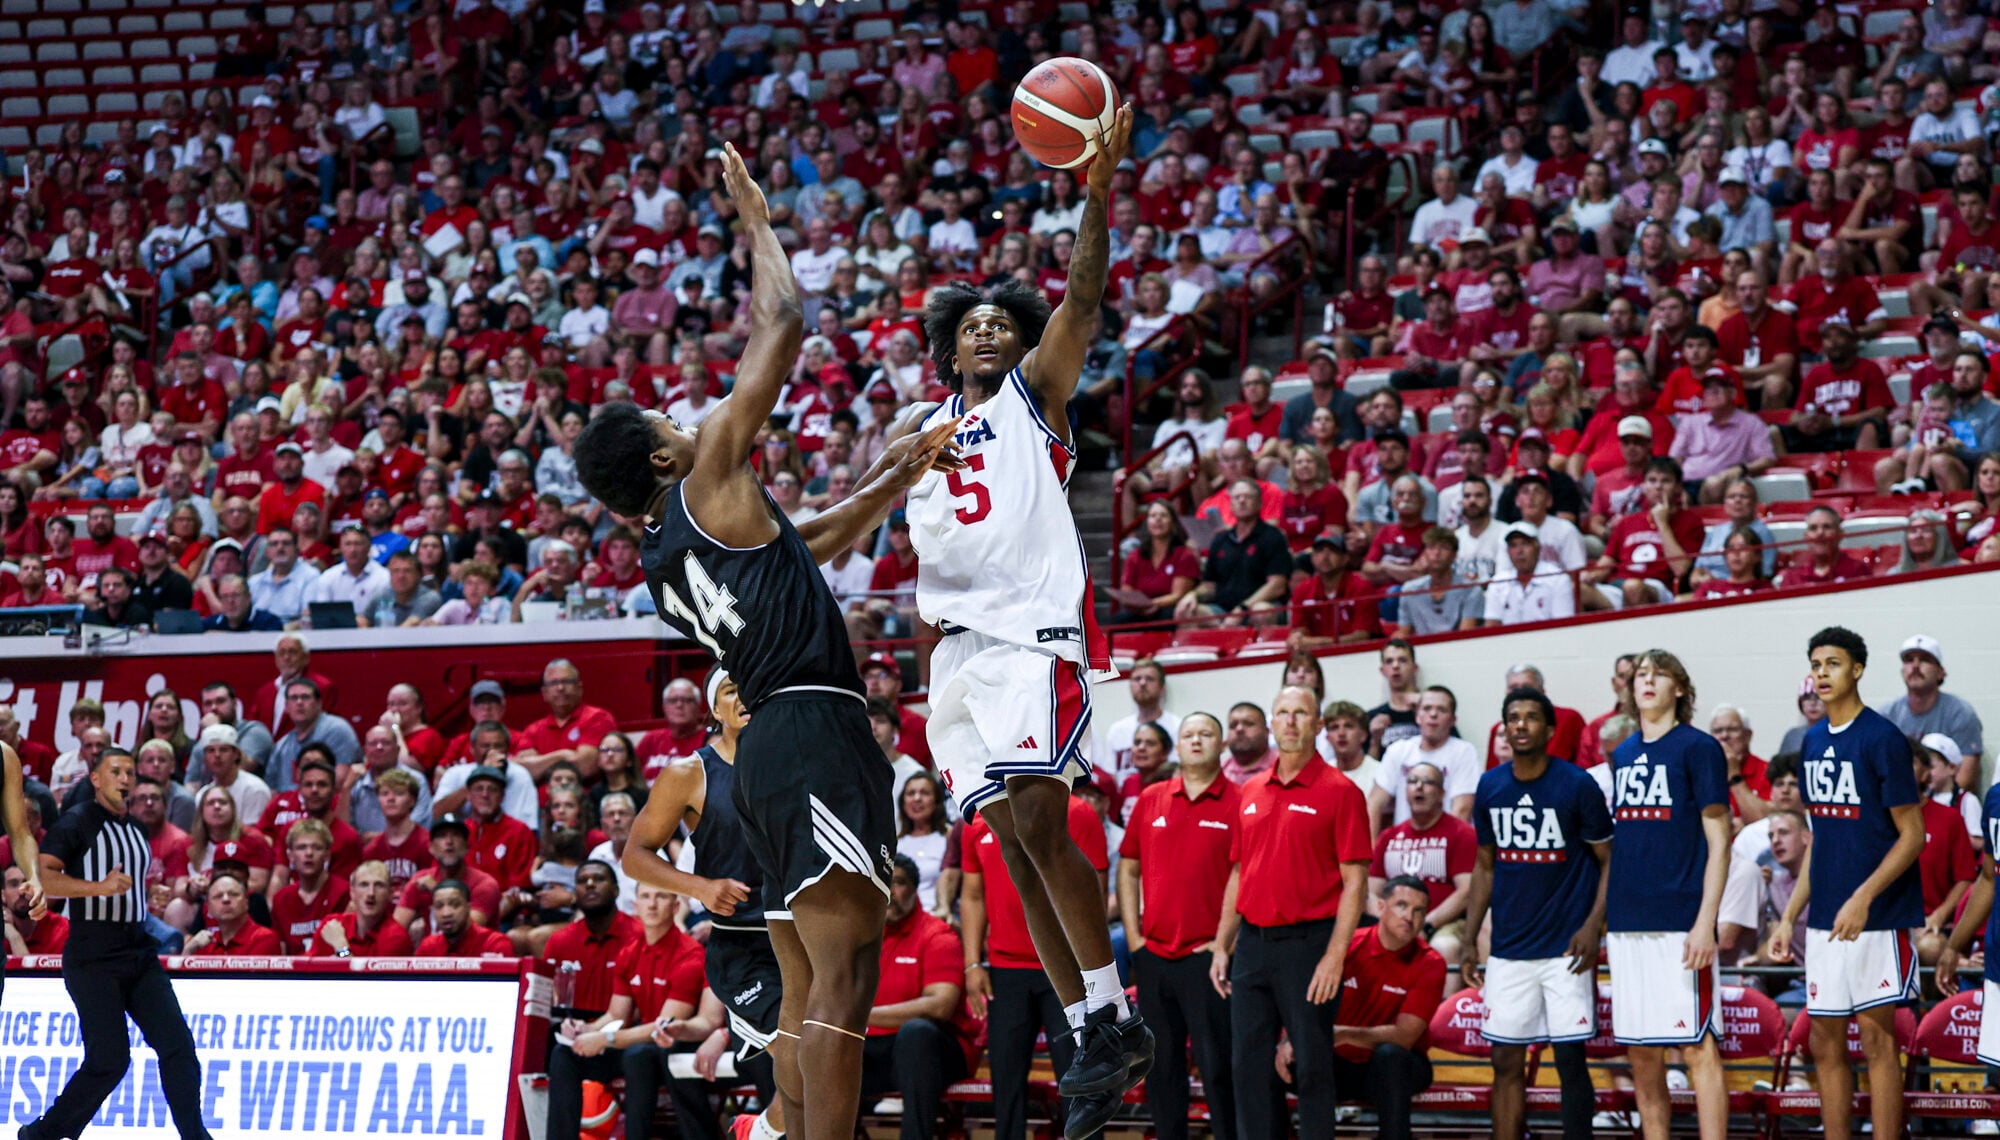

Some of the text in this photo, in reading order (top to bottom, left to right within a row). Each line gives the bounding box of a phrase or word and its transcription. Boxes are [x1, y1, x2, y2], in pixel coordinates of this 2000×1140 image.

[946, 453, 992, 525] 5
[662, 549, 746, 661] 14
[1616, 764, 1673, 806] USA
[1804, 760, 1861, 804] USA
[1489, 807, 1566, 849] USA
[184, 957, 222, 969] German
[223, 957, 269, 969] American
[367, 958, 408, 970] German
[408, 959, 456, 970] American
[233, 1014, 283, 1050] LIFE
[290, 1015, 395, 1052] THROWS
[400, 1016, 431, 1053] AT
[437, 1017, 494, 1053] YOU.
[239, 1060, 362, 1133] WITH
[366, 1062, 485, 1136] AAA.
